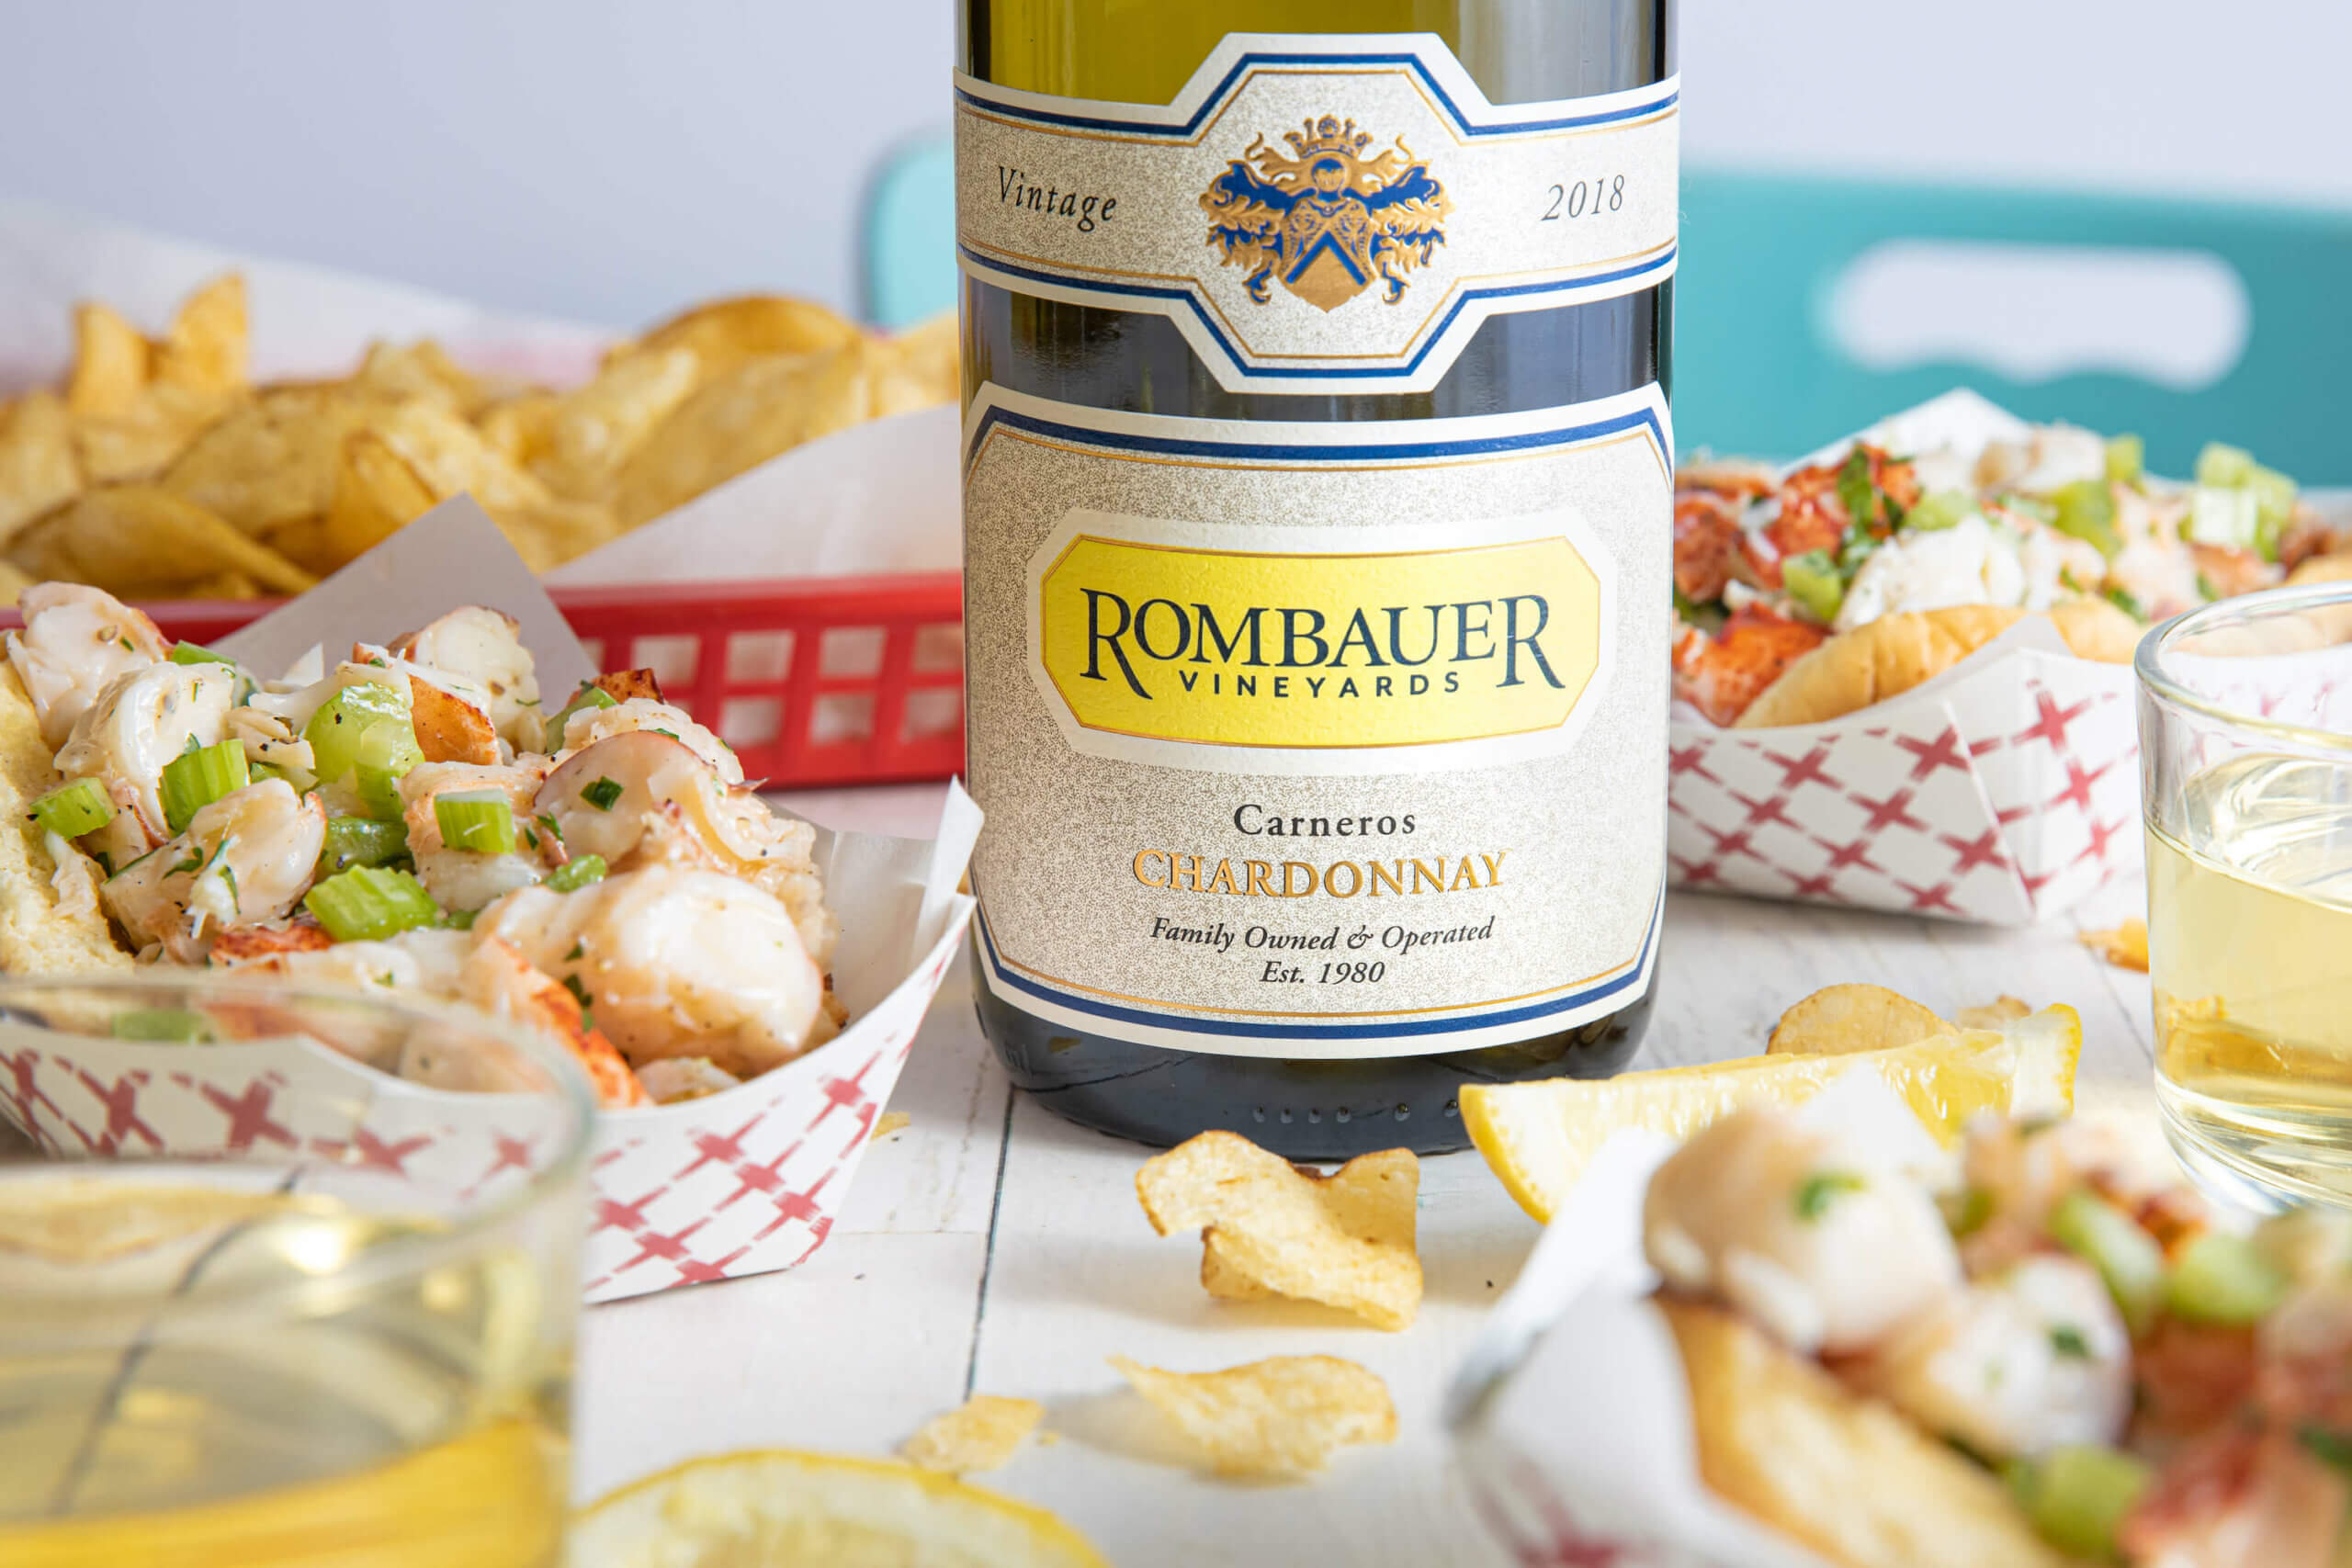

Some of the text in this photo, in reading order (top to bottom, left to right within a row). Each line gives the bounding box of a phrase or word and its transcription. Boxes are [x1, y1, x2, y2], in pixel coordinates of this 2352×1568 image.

[998, 166, 1117, 232] Vintage
[1541, 175, 1625, 222] 2018
[1080, 588, 1566, 700] ROMBAUER
[1180, 671, 1459, 697] VINEYARDS
[1234, 804, 1416, 837] Carneros
[1133, 849, 1512, 898] CHARDONNAY
[1150, 916, 1496, 955] Family Owned & Operated
[1259, 961, 1385, 985] Est. 1980
